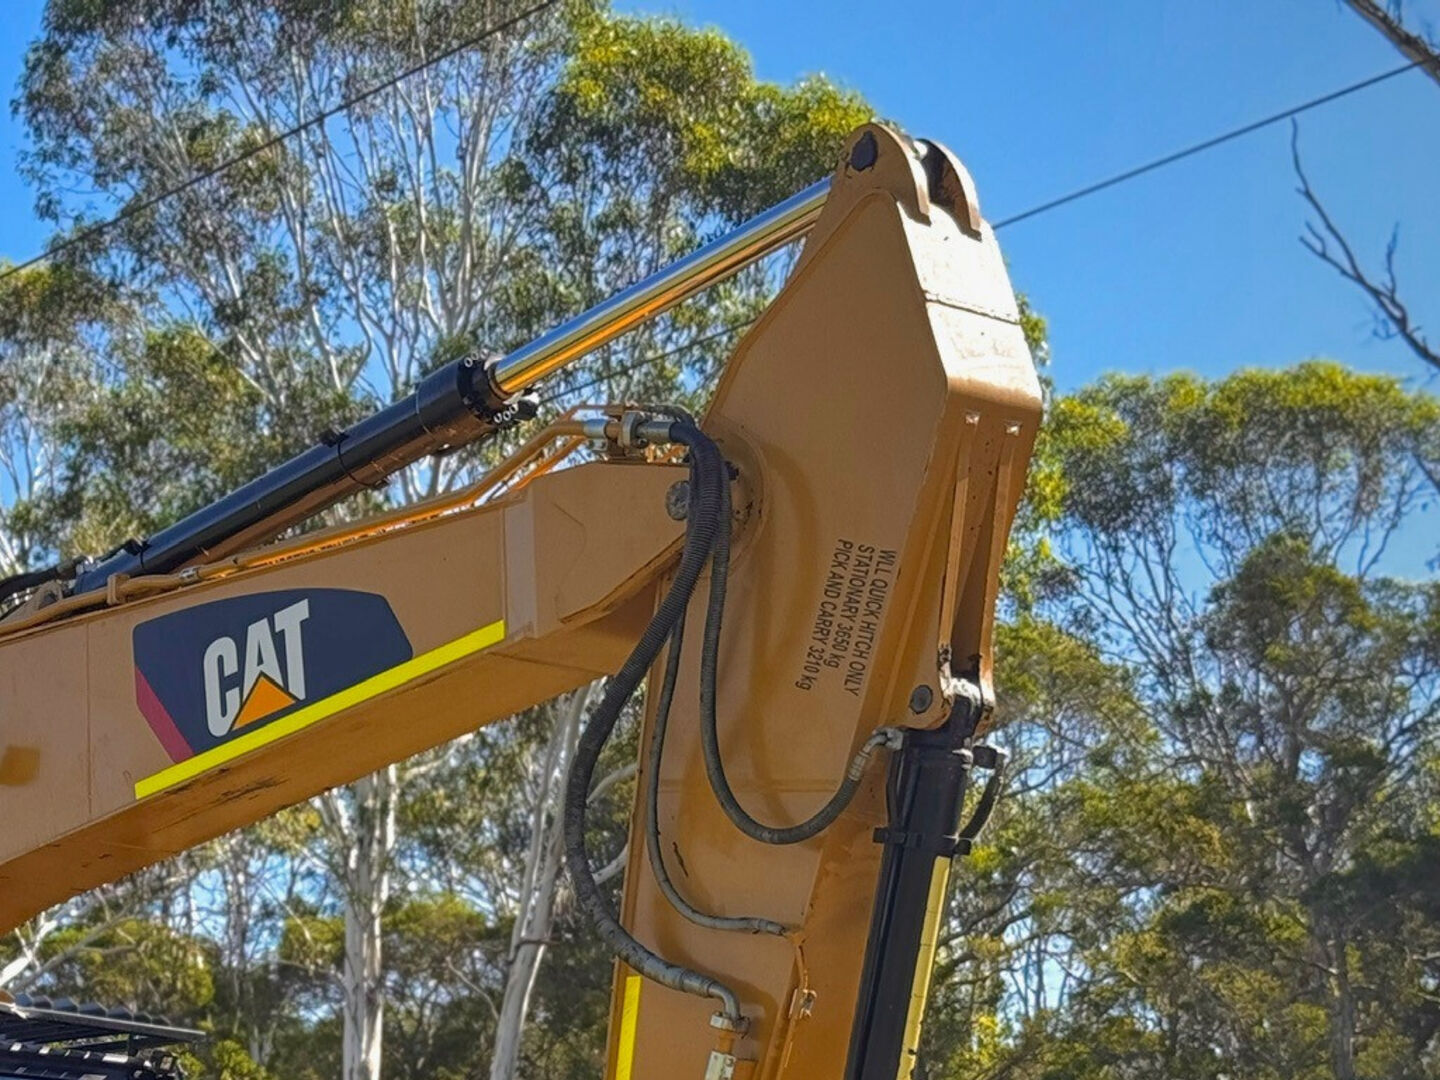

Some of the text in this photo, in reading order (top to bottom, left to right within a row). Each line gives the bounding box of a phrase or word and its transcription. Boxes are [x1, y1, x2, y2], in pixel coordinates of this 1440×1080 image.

[203, 598, 310, 738] CAT
[795, 539, 854, 691] PICK AND CARRY 3210 kg
[823, 544, 875, 669] STATIONARY 3650 kg
[844, 549, 897, 697] WLL QUICK HITCH ONLY
